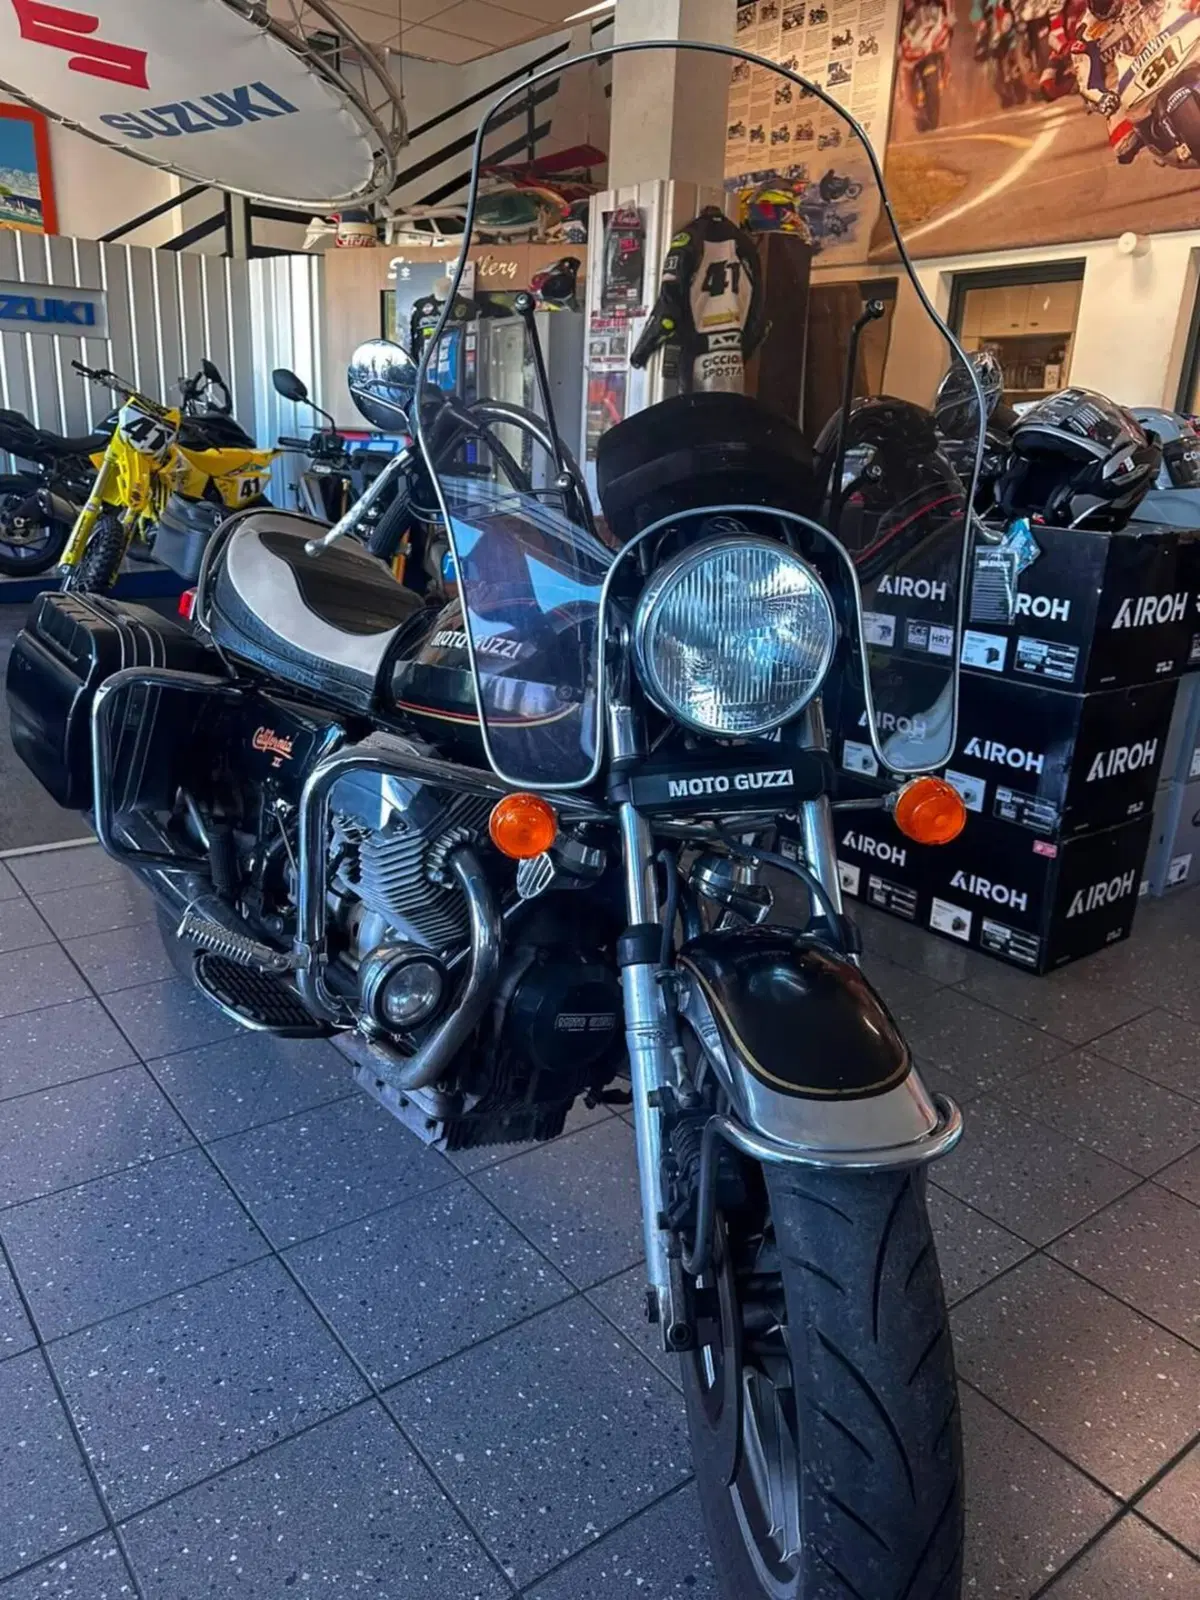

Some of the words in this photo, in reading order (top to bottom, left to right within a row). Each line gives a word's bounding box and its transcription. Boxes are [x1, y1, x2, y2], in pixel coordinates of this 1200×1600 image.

[100, 81, 299, 139] SUZUKI
[702, 260, 740, 297] 41
[121, 416, 171, 450] 41
[240, 477, 260, 498] 41
[877, 574, 947, 601] AIROH
[1015, 592, 1071, 622] ROH
[1112, 592, 1188, 629] AIROH
[431, 630, 467, 649] MOTO
[252, 726, 293, 760] California
[963, 736, 1044, 774] AIROH
[1086, 737, 1158, 783] AIROH
[668, 775, 729, 798] MOTO
[734, 768, 794, 790] GUZZI
[842, 830, 906, 867] AIROH
[949, 870, 1028, 912] AIROH
[1066, 868, 1135, 918] AIROH
